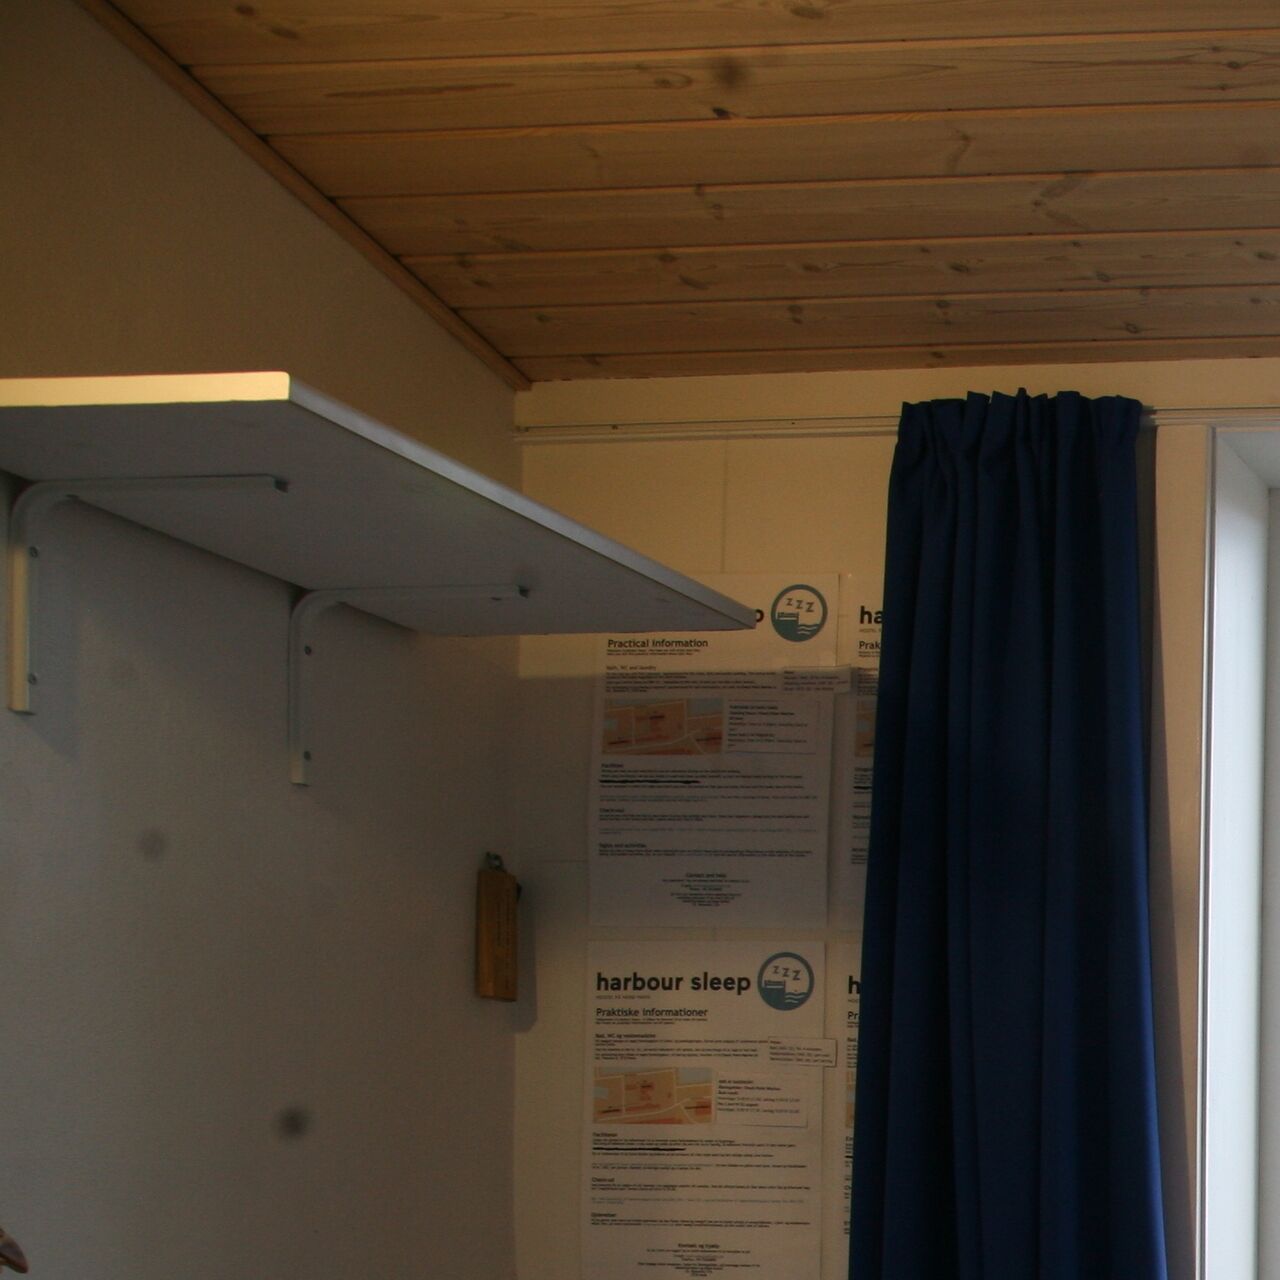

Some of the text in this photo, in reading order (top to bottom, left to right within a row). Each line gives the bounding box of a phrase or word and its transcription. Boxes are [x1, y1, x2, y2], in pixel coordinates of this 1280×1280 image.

[607, 638, 650, 649] Practical
[596, 972, 751, 995] harbour sleep
[596, 1008, 640, 1017] Praktiske
